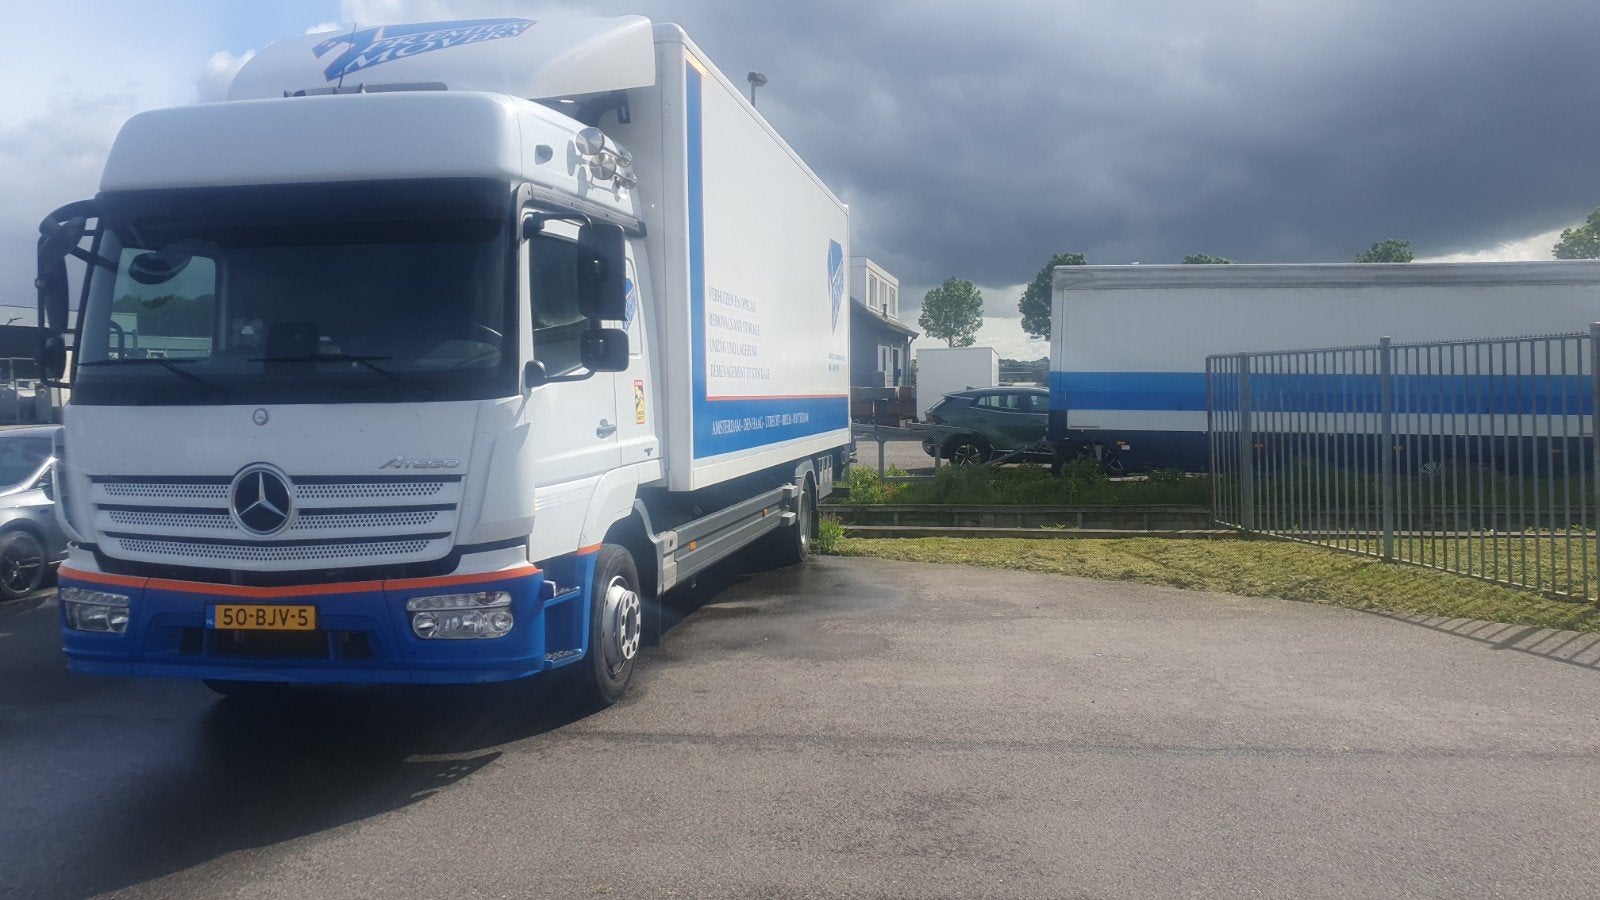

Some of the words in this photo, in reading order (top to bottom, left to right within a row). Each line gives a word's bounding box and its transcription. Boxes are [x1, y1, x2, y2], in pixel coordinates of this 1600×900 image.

[345, 29, 521, 70] MOVERS
[708, 313, 734, 331] REMOVALS
[742, 321, 760, 337] STORAGE
[712, 419, 741, 436] AMSTERDAM
[223, 608, 308, 626] 50-BJV-5
